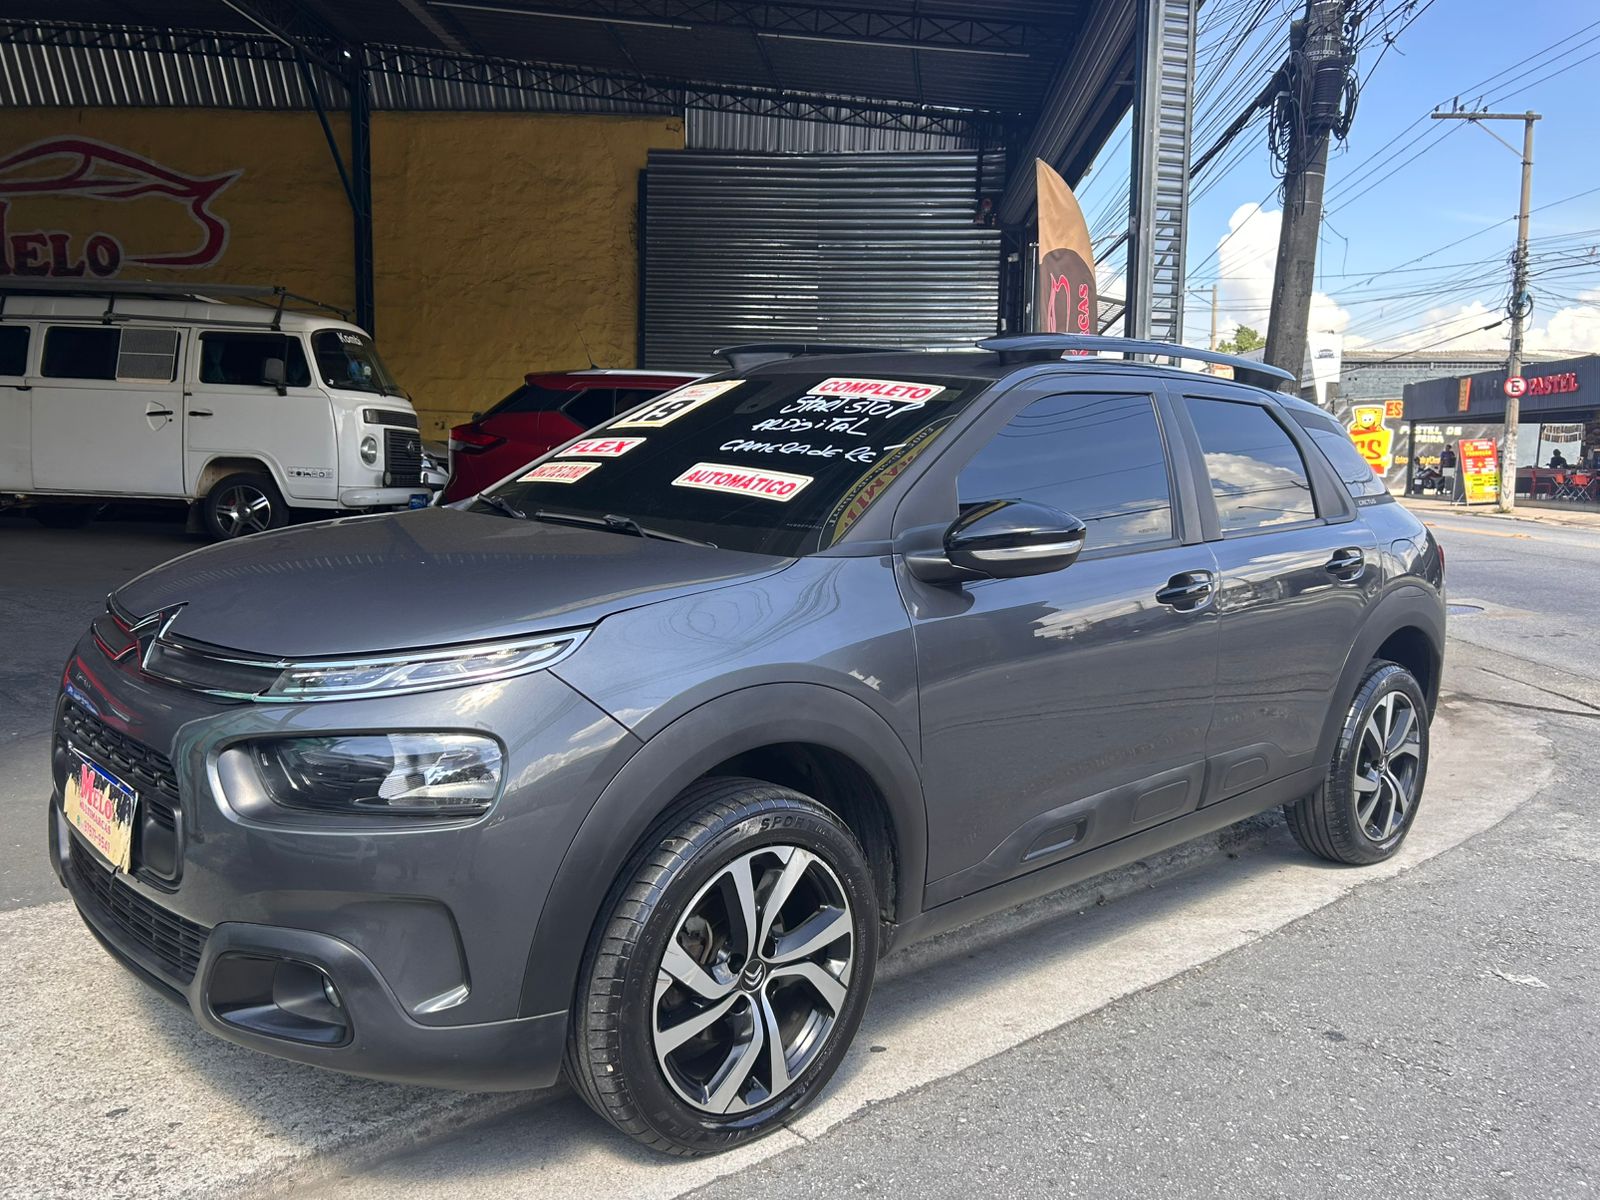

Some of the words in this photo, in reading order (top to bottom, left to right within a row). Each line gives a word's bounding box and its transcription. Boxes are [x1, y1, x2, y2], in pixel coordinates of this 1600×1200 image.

[819, 381, 932, 399] COMPLETO
[1528, 373, 1579, 396] PASTEL
[627, 399, 697, 422] 19
[1399, 425, 1442, 435] PSTEL
[1446, 426, 1462, 435] DE
[569, 440, 635, 453] FLEX
[683, 470, 797, 495] AUTOMÁTICO
